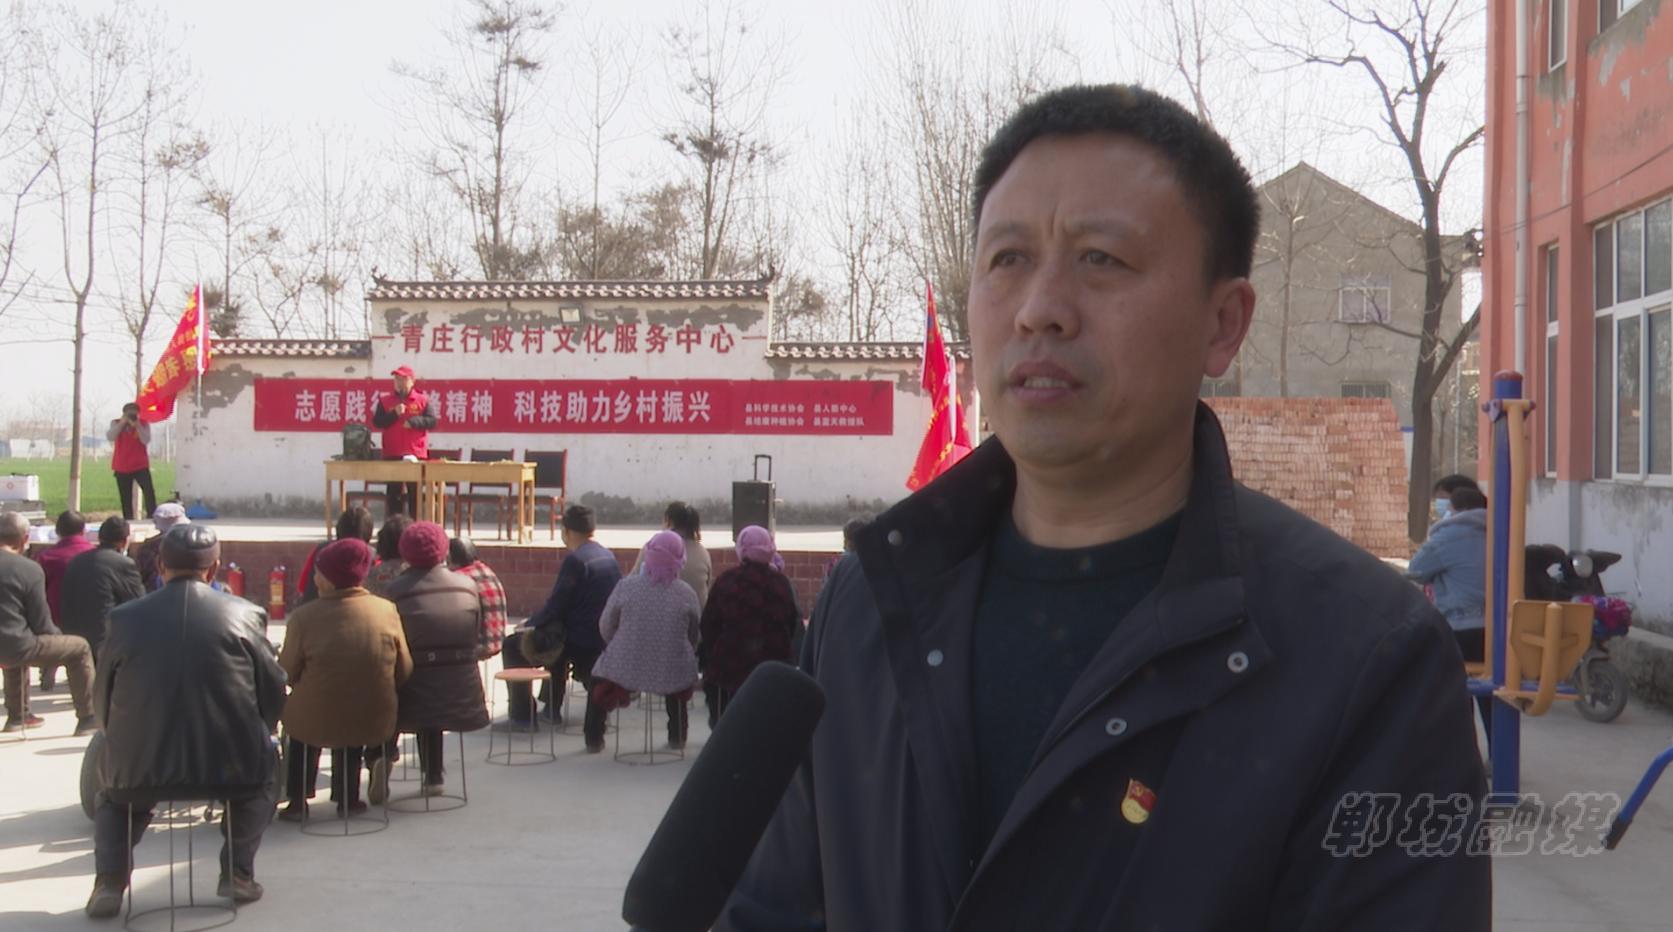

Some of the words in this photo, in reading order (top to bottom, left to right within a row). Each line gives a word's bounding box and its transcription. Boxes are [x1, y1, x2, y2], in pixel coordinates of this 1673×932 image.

[401, 323, 736, 354] 青庄行政村文化服务中心
[513, 389, 712, 424] 科技助力乡村振兴
